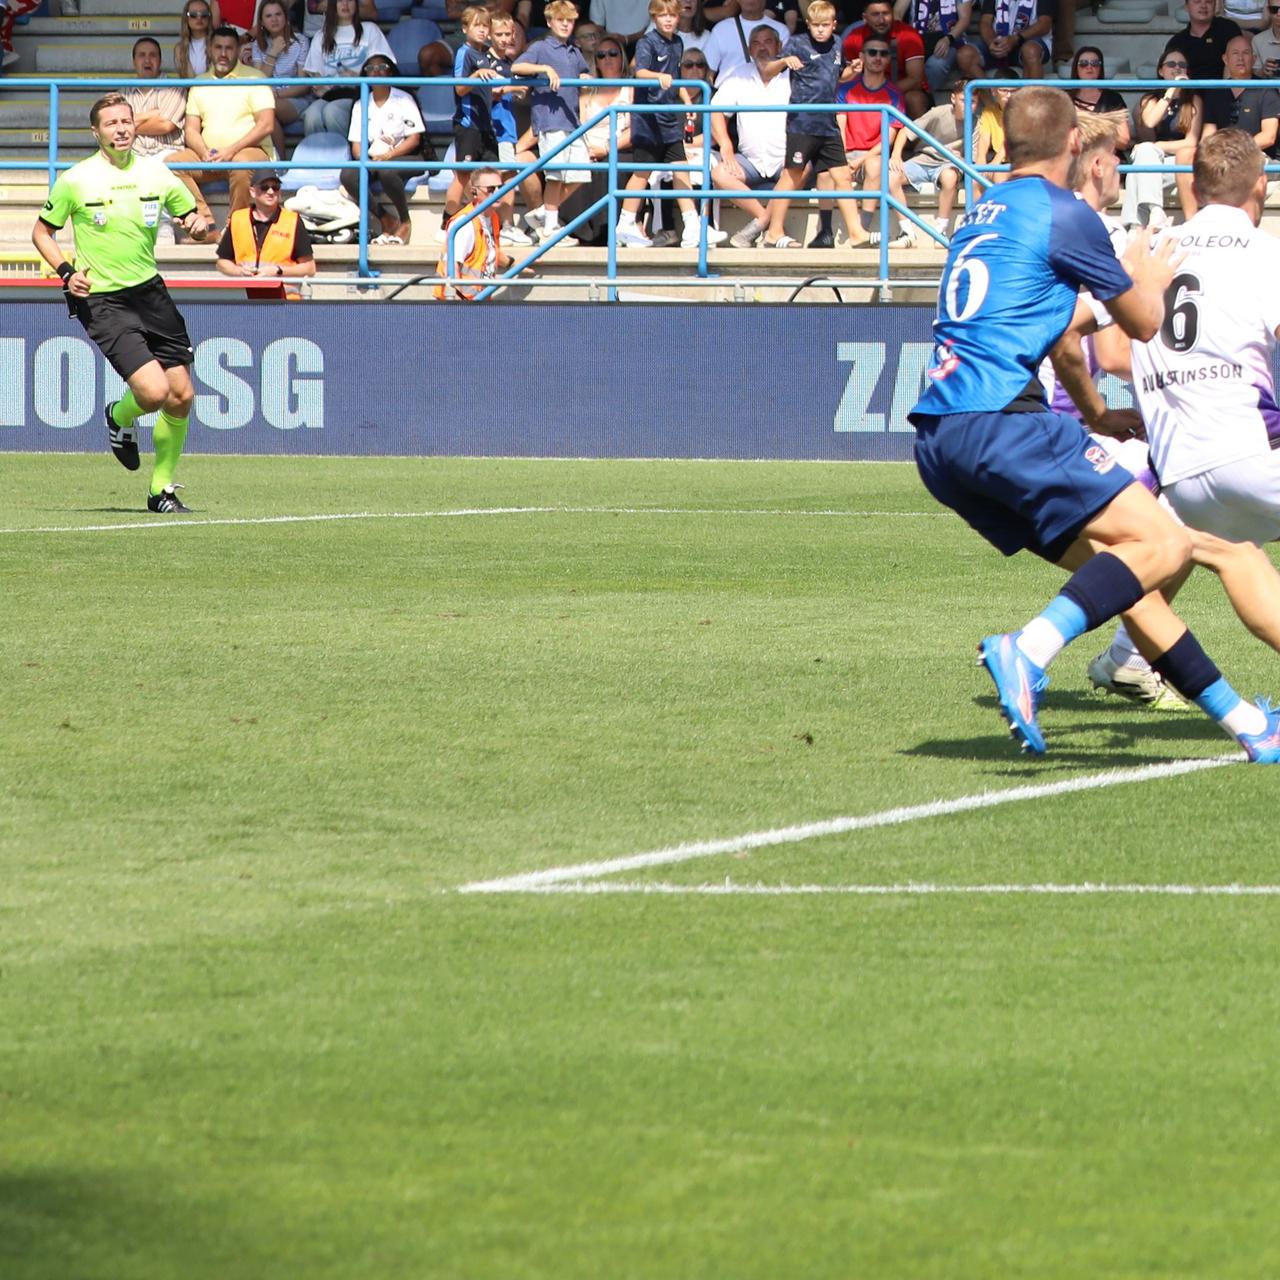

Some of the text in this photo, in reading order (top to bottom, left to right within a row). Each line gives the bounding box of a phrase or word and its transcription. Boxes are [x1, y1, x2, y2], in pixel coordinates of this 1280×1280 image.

[944, 233, 999, 323] 6
[1162, 271, 1203, 352] 6
[194, 337, 325, 430] SG
